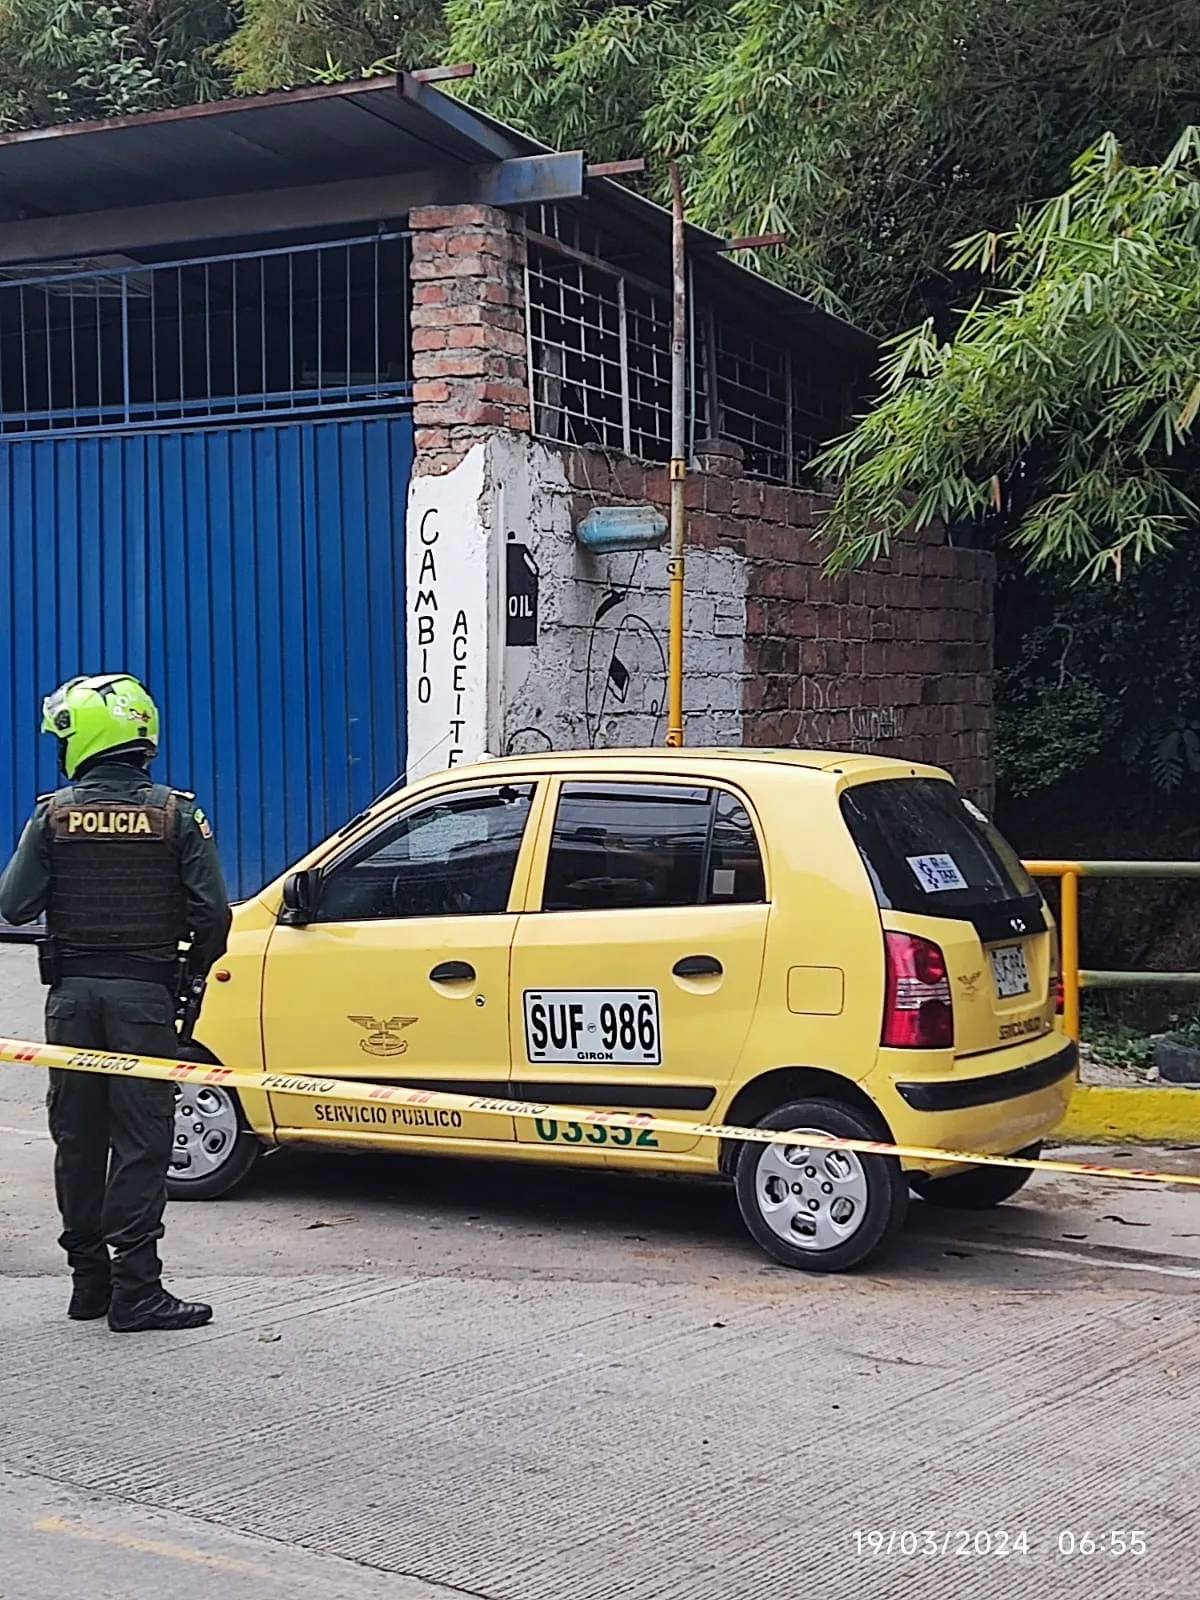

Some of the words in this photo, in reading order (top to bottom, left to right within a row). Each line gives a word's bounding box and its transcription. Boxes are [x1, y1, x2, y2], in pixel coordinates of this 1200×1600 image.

[414, 508, 439, 703] CAMBIO
[508, 595, 533, 617] OIL
[68, 811, 152, 833] POLICIA
[531, 1003, 583, 1049] SUF
[600, 1003, 655, 1050] 986
[67, 1052, 139, 1071] PELIGRO
[577, 1052, 613, 1060] GIRON
[261, 1076, 335, 1092] PELIGRO
[314, 1104, 386, 1123] SERVICIO
[392, 1109, 462, 1127] PUBLICO
[469, 1097, 549, 1114] PELIGRO
